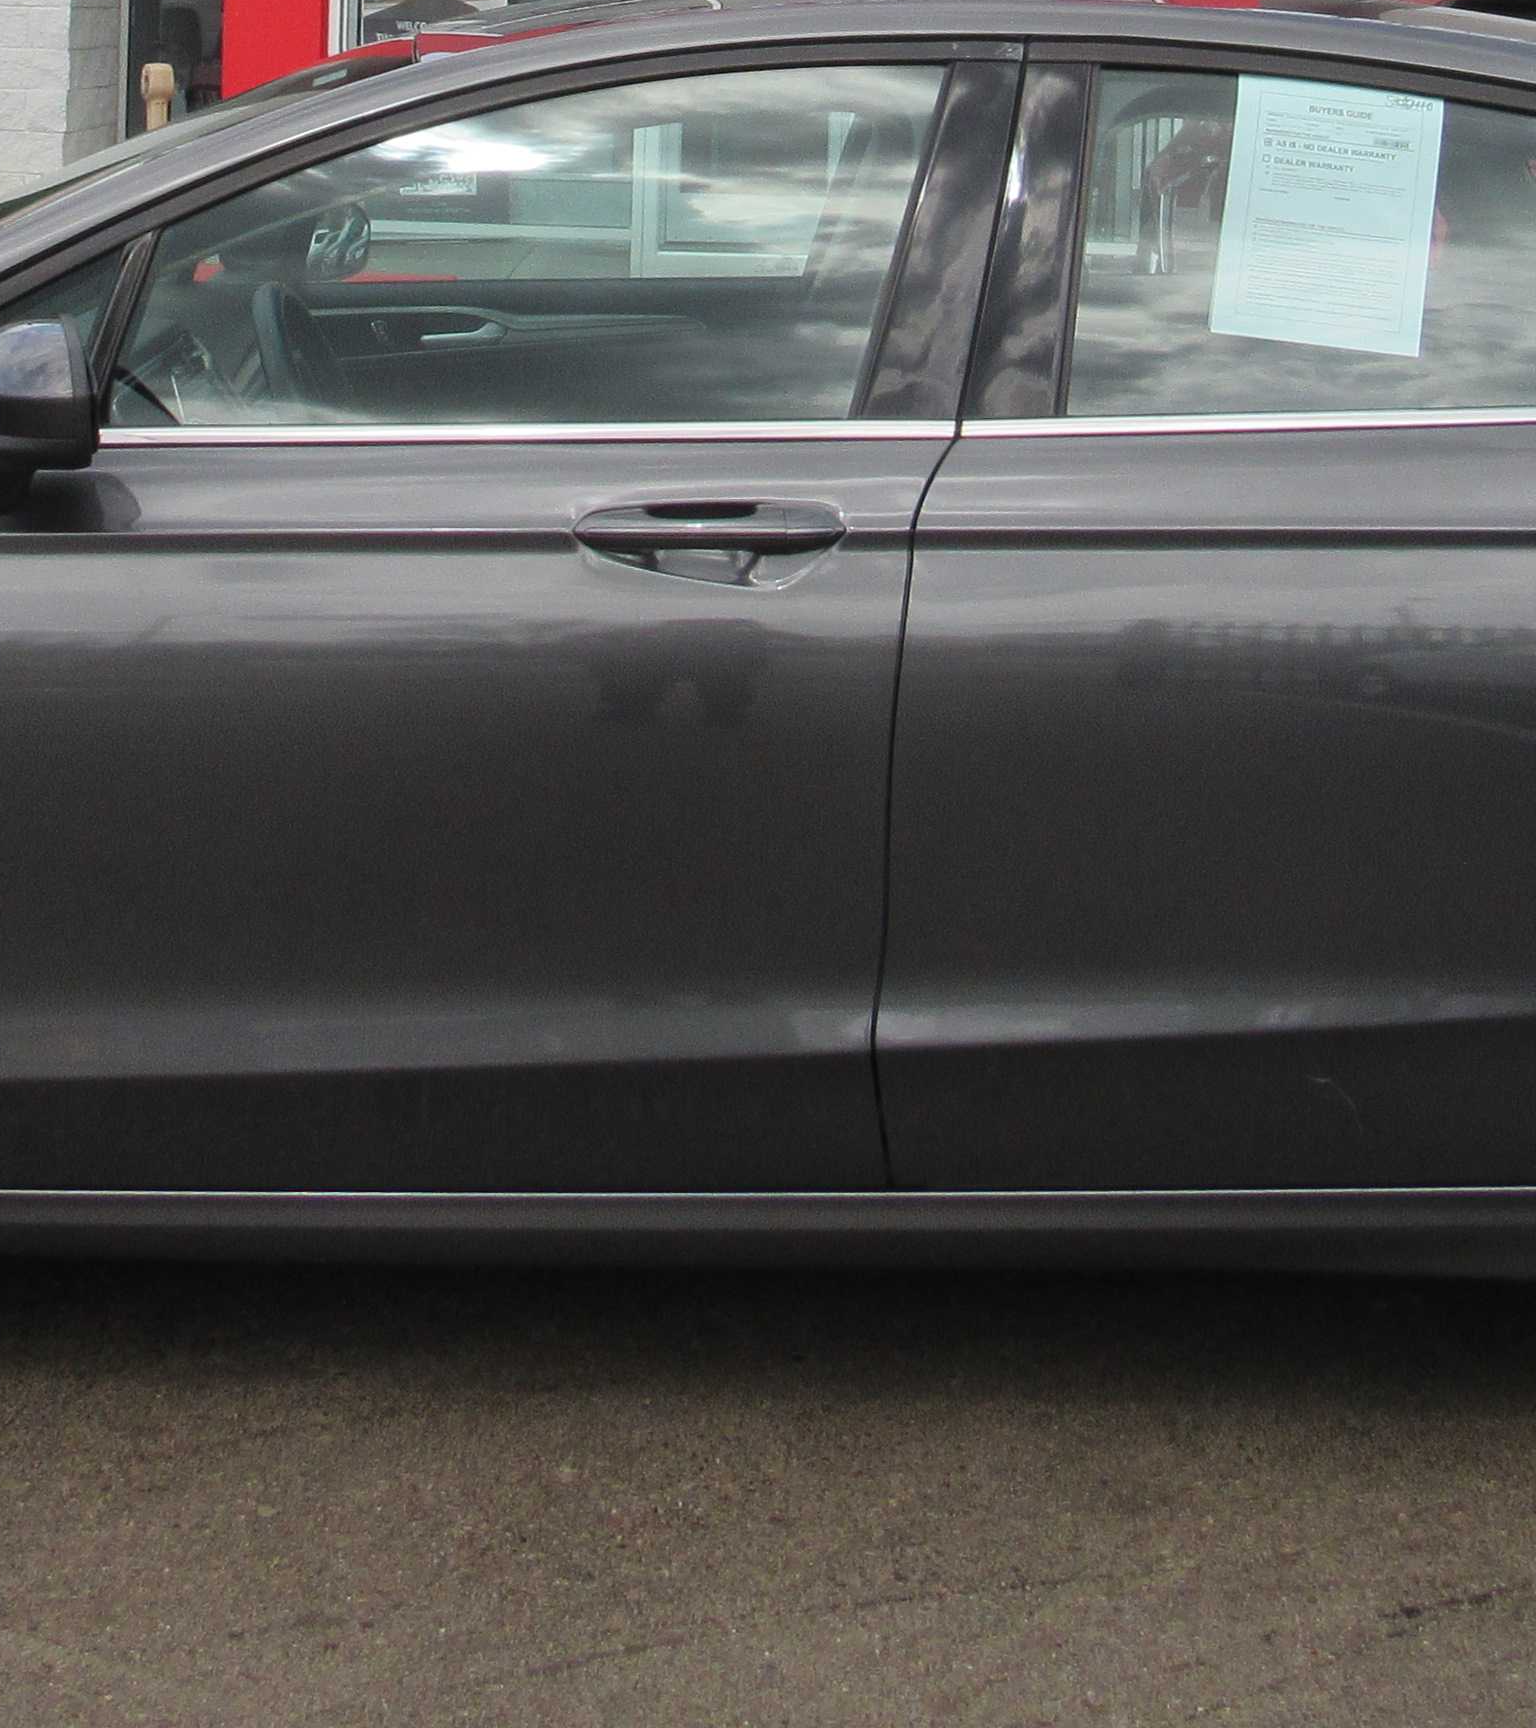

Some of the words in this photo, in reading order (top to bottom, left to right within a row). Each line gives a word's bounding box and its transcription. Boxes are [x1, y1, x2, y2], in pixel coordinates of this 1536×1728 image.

[1308, 105, 1345, 117] BUYERS
[1346, 109, 1373, 121] GUIDE
[1275, 139, 1287, 148] AS
[1303, 143, 1316, 152] NO
[1317, 145, 1349, 155] DEALER
[1351, 149, 1398, 161] WARRANTY
[1273, 155, 1307, 167] DEALER
[1308, 160, 1354, 173] WARRANTY
